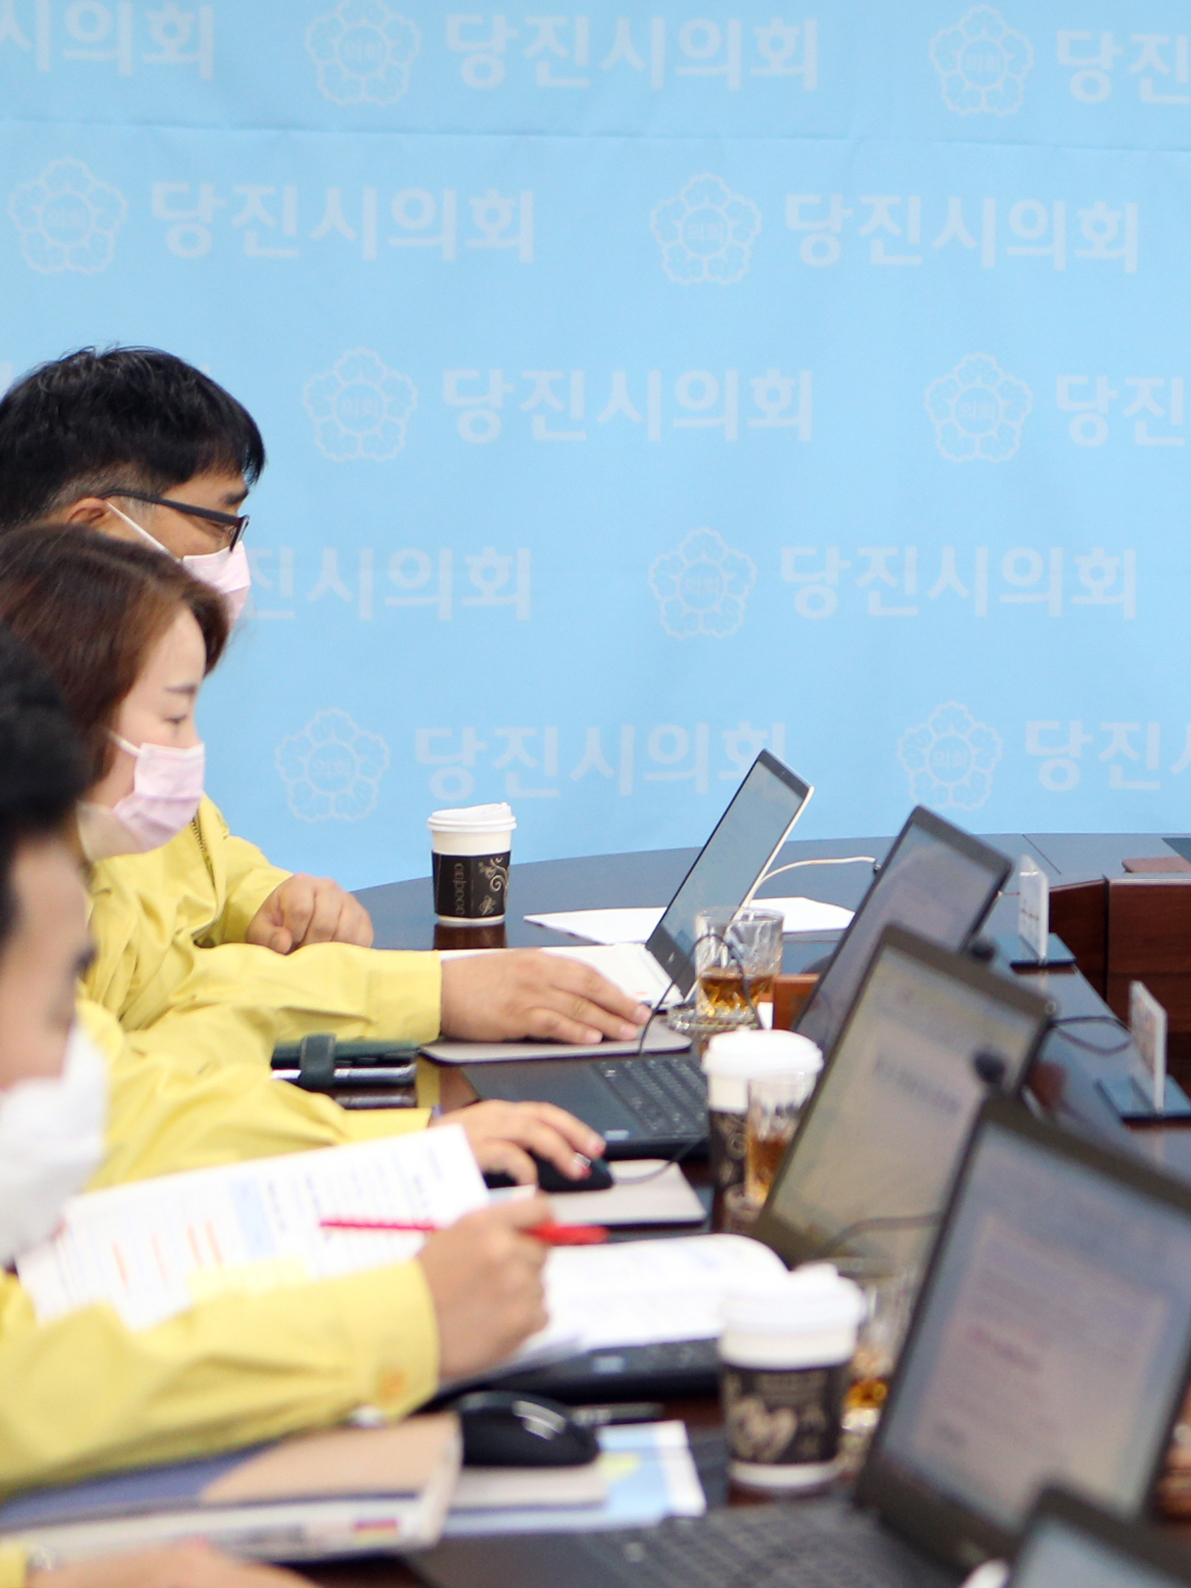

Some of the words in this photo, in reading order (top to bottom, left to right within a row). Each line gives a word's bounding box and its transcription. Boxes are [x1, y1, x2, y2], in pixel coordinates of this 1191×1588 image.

[446, 13, 819, 91] 당진시의회
[151, 181, 535, 263] 당진시의회
[785, 193, 1139, 273] 당진시의회
[442, 368, 813, 444] 당진시의회
[780, 545, 1137, 621] 당진시의회
